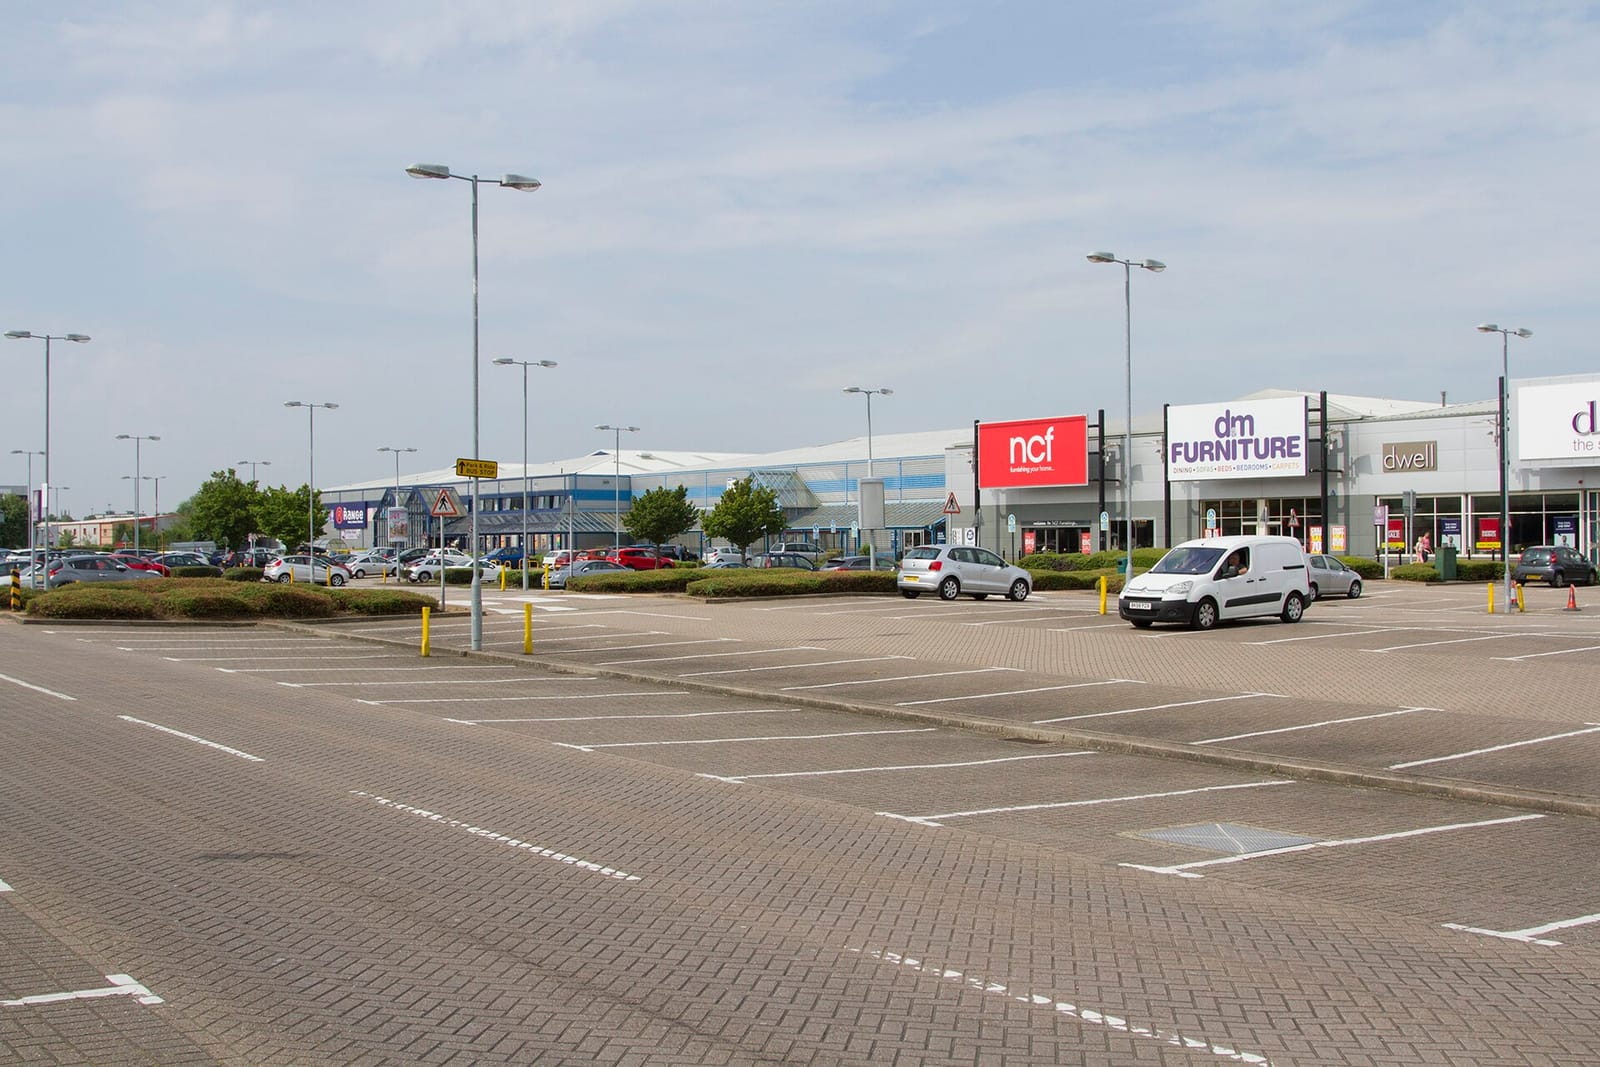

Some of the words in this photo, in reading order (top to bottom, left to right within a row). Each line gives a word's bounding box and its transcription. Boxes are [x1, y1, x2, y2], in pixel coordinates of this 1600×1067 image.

[1010, 426, 1054, 464] ncf
[1171, 435, 1301, 463] FURNITURE
[1383, 443, 1434, 469] dwell
[1573, 440, 1594, 451] the
[1173, 466, 1192, 474] DINING
[1196, 465, 1214, 473] SOFAS
[1236, 463, 1269, 471] BEDROOMS
[1272, 462, 1300, 470] CARPETS
